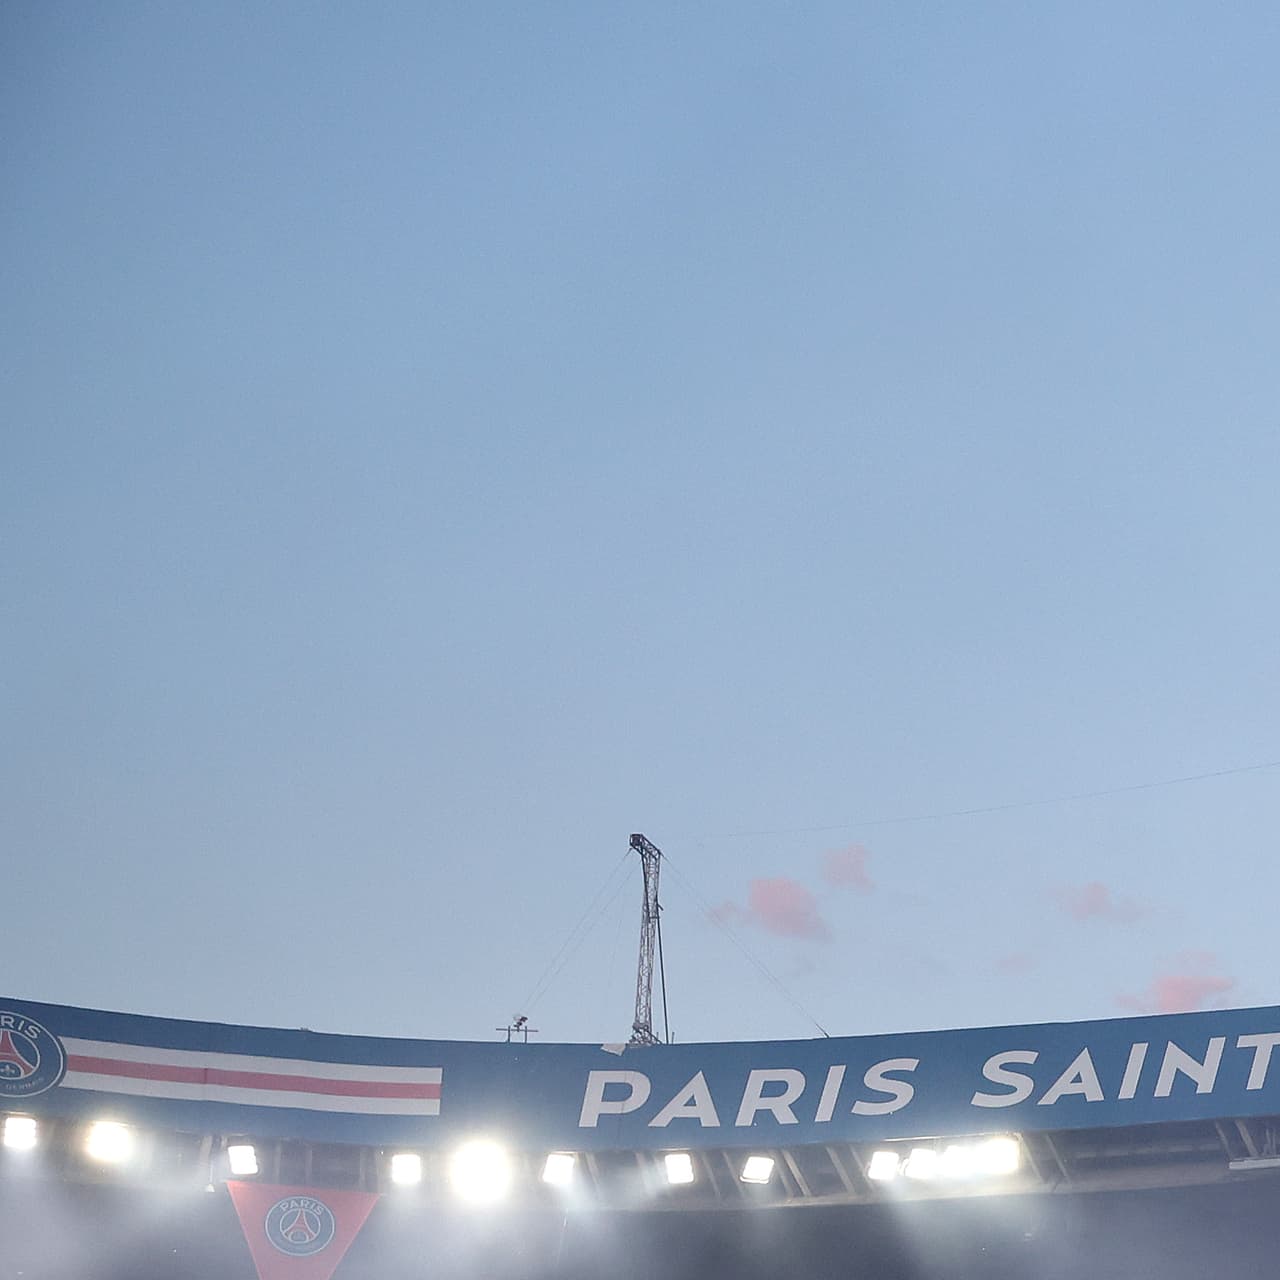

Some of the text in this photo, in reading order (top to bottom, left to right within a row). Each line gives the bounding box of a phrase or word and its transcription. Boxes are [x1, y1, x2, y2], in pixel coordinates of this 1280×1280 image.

[0, 1015, 41, 1039] RIS
[577, 1057, 921, 1129] PARIS
[280, 1199, 324, 1216] PARIS
